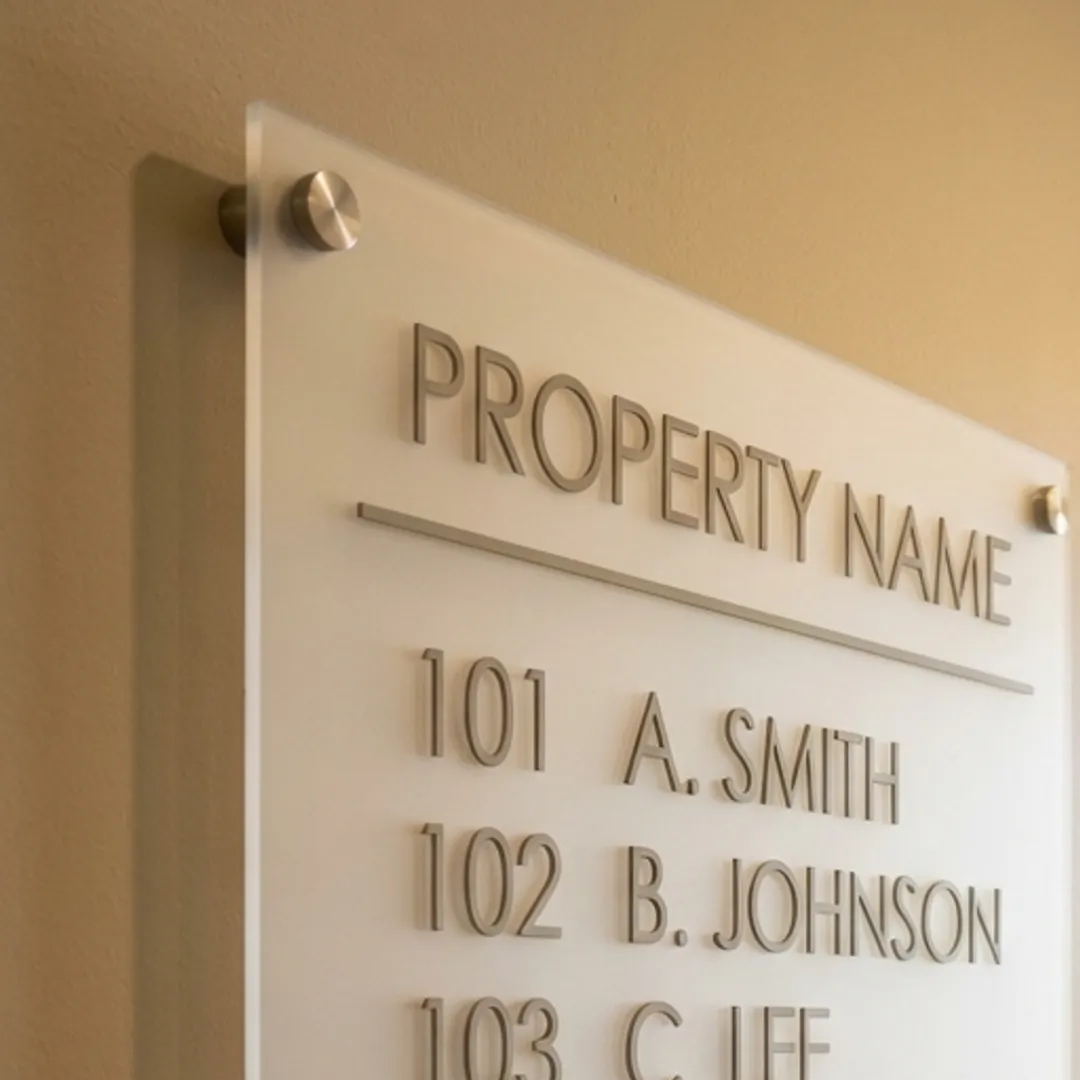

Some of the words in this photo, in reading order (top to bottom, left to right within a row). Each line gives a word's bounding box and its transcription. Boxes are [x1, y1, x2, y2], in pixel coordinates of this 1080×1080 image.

[413, 322, 822, 564] PROPERTY
[843, 482, 1012, 627] NAME
[421, 648, 546, 772] 101
[622, 691, 700, 796] A.
[720, 708, 900, 826] SMITH
[420, 822, 563, 938] 102
[626, 845, 689, 947] B.
[711, 857, 1001, 966] JOHNSON
